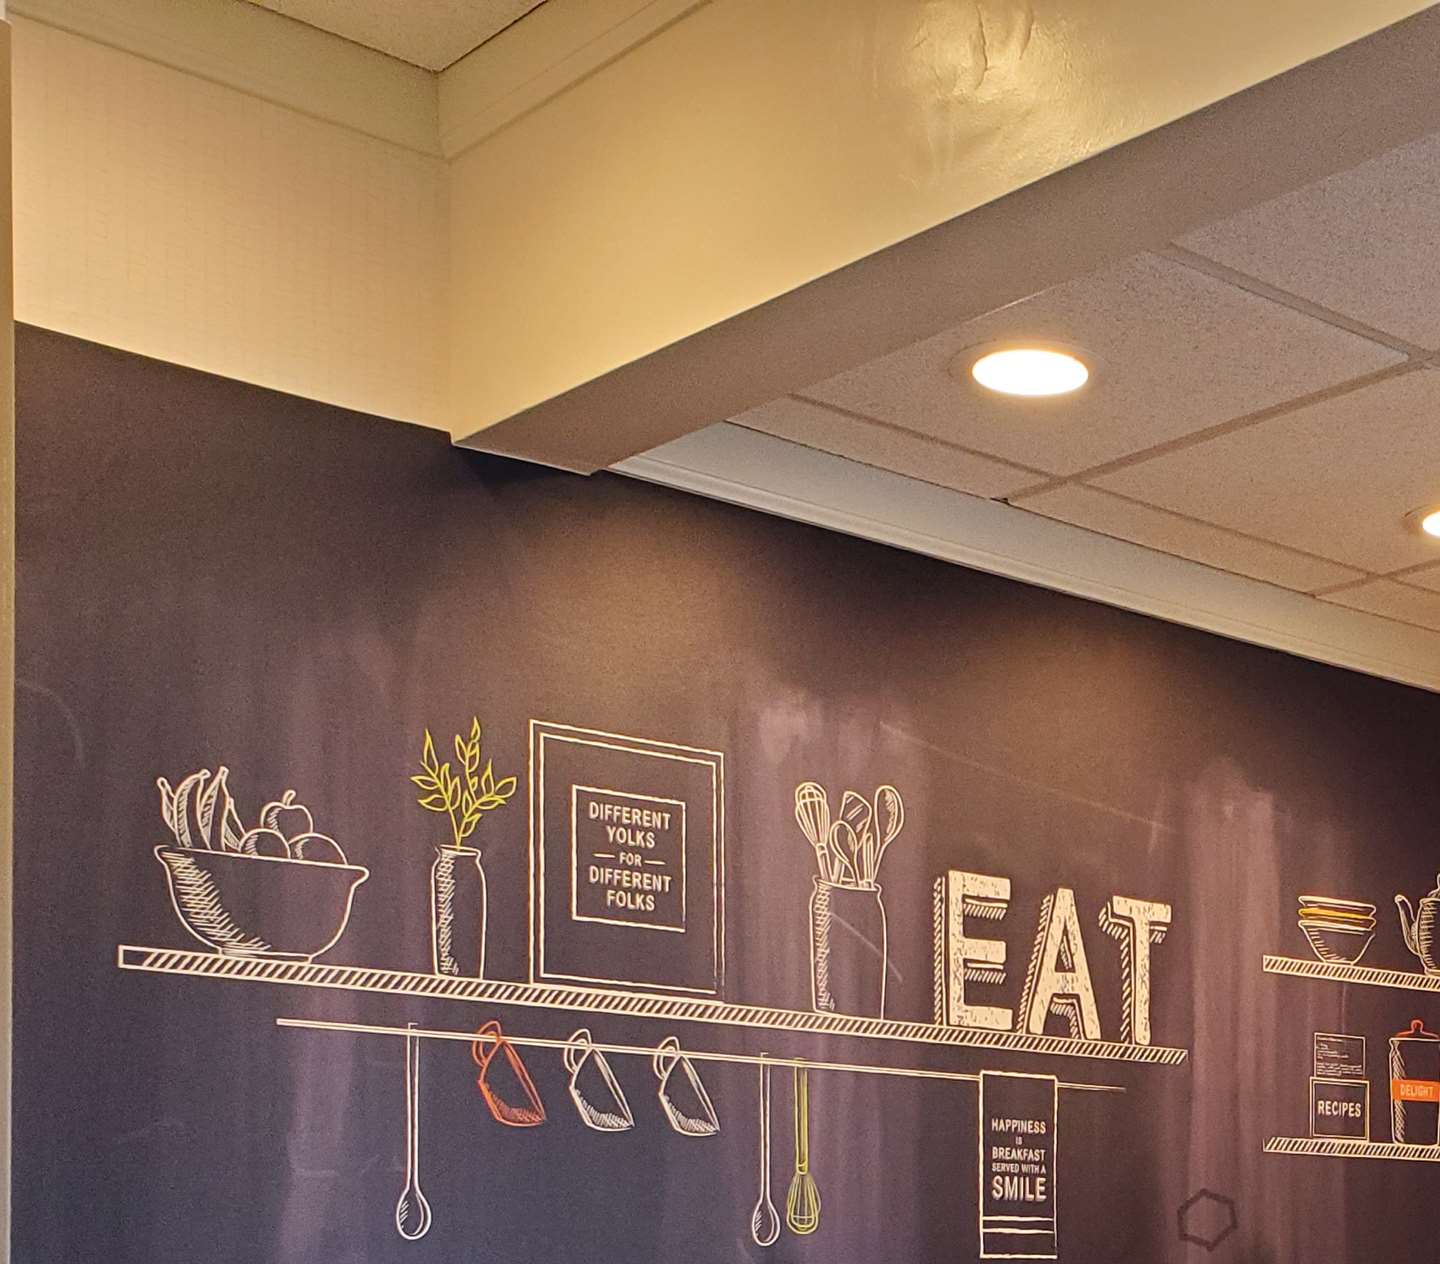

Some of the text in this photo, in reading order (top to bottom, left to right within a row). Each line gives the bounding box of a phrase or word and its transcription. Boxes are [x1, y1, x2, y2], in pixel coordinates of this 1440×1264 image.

[589, 802, 671, 831] DIFFERENT
[606, 826, 655, 849] YOLKS
[619, 852, 642, 867] FOR
[589, 865, 672, 893] DIFFERENT
[607, 890, 655, 912] FOLKS
[934, 870, 1172, 1045] EAT
[1400, 1084, 1434, 1097] DELIGHT
[1317, 1100, 1361, 1118] RECIPES
[991, 1118, 1046, 1134] HAPPINESS
[1015, 1136, 1022, 1145] IS
[991, 1146, 1046, 1161] BREAKFAST
[991, 1162, 1046, 1174] SERVED WITH A
[991, 1175, 1047, 1201] SMILE
